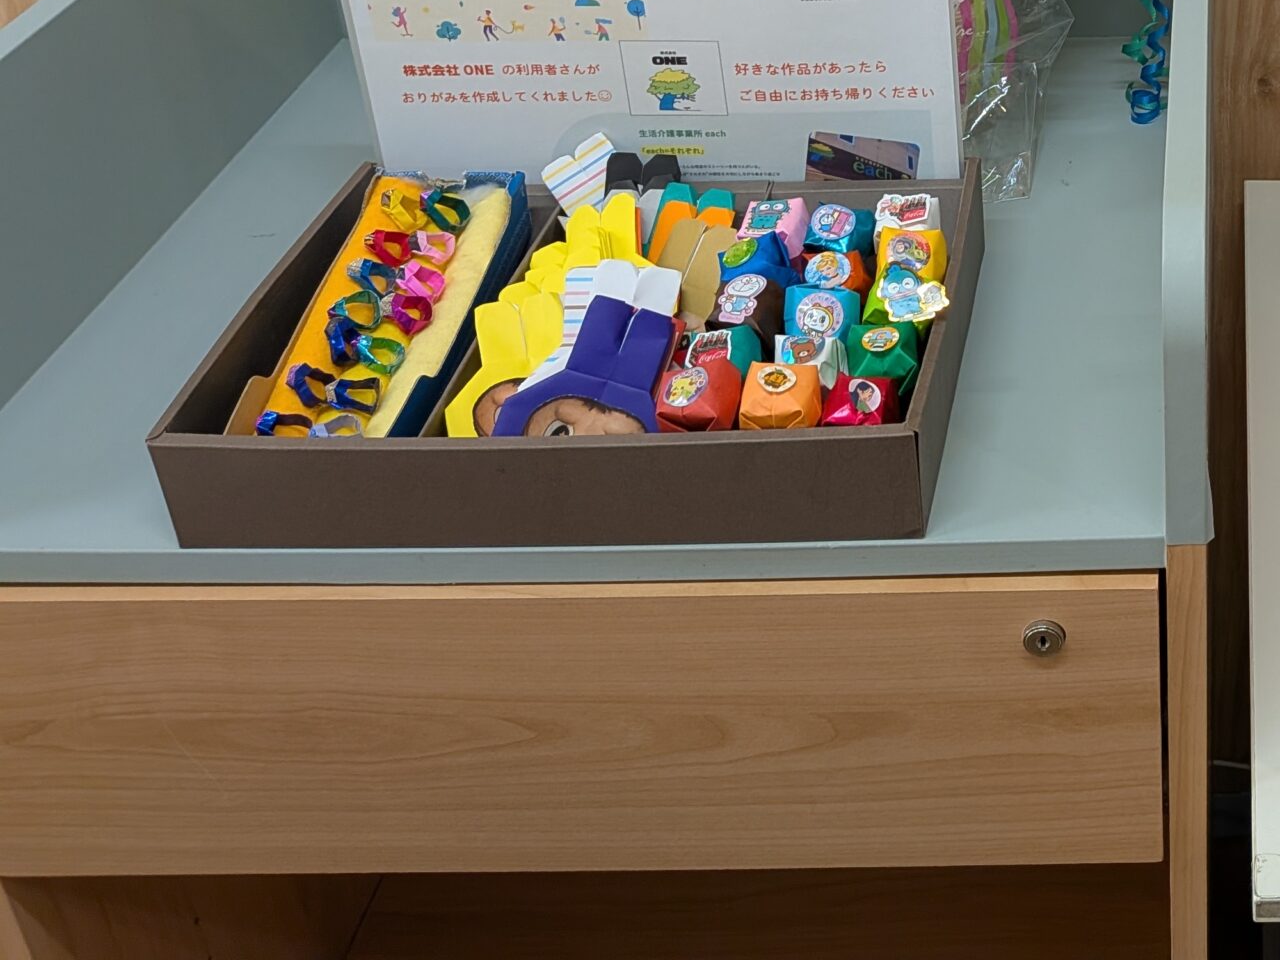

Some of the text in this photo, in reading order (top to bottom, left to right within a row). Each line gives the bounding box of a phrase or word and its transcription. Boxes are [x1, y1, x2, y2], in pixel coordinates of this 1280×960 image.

[652, 56, 688, 65] ONE
[403, 63, 600, 77] 株式会社 ONE の利用者さんが
[734, 60, 888, 76] 好きな作品があったら
[740, 86, 936, 102] ご自由にお持ち帰りください
[705, 130, 727, 138] each
